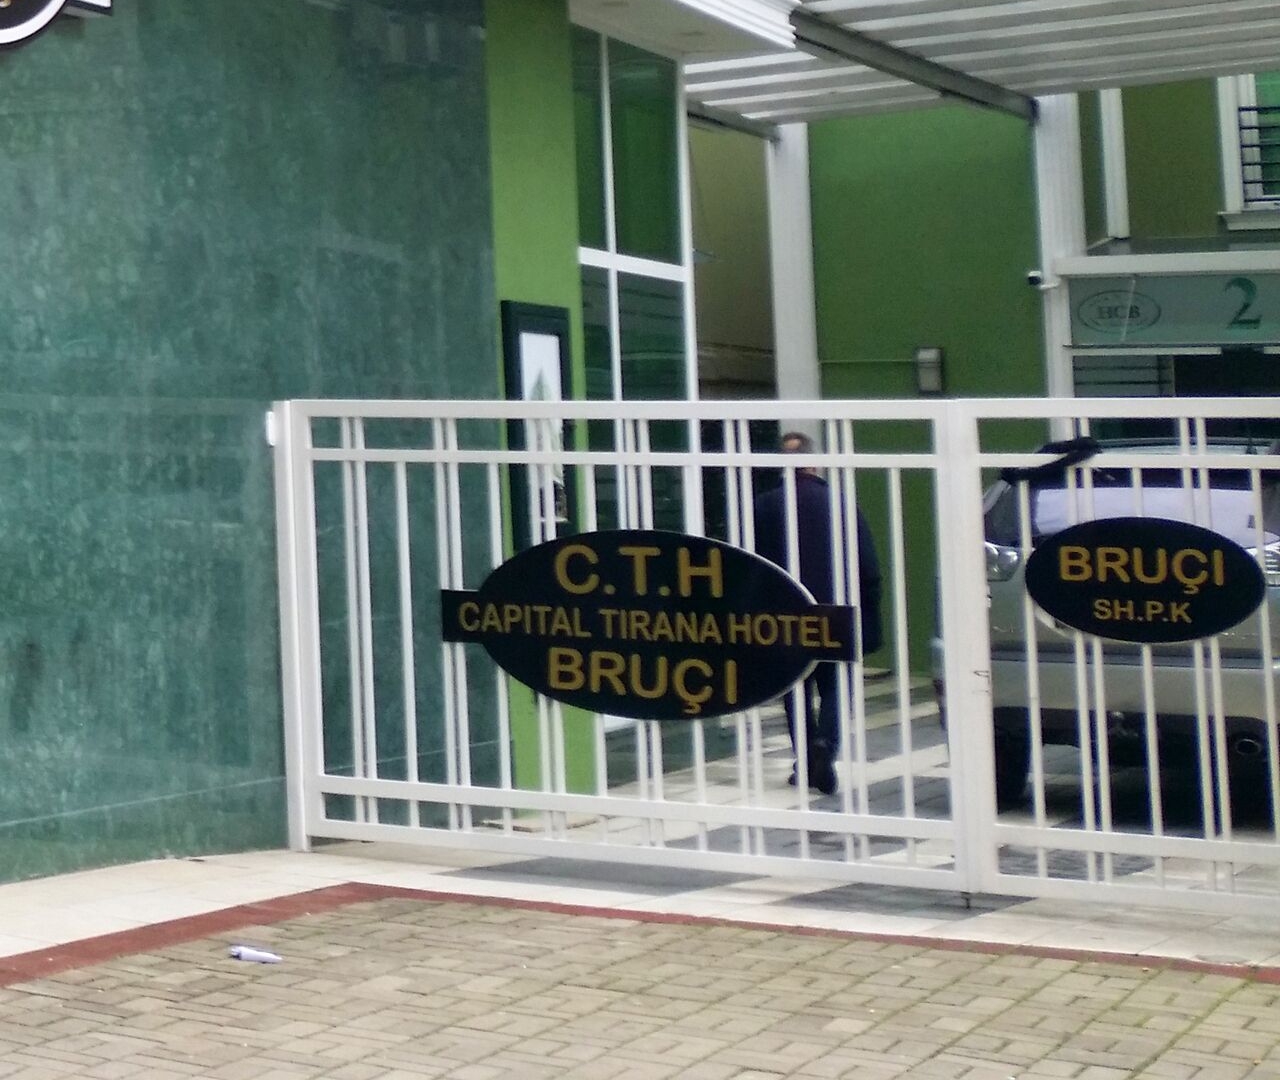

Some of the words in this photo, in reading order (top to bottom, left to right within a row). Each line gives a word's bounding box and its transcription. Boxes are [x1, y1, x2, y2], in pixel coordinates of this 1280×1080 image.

[1223, 277, 1262, 330] 2
[553, 543, 724, 599] C.T.H
[1058, 545, 1226, 595] BRUÇI
[458, 601, 591, 639] CAPITAL
[599, 607, 723, 645] TIRANA
[728, 613, 842, 649] HOTEL
[1093, 599, 1193, 624] SH.P.K
[548, 647, 739, 715] BRUÇI
